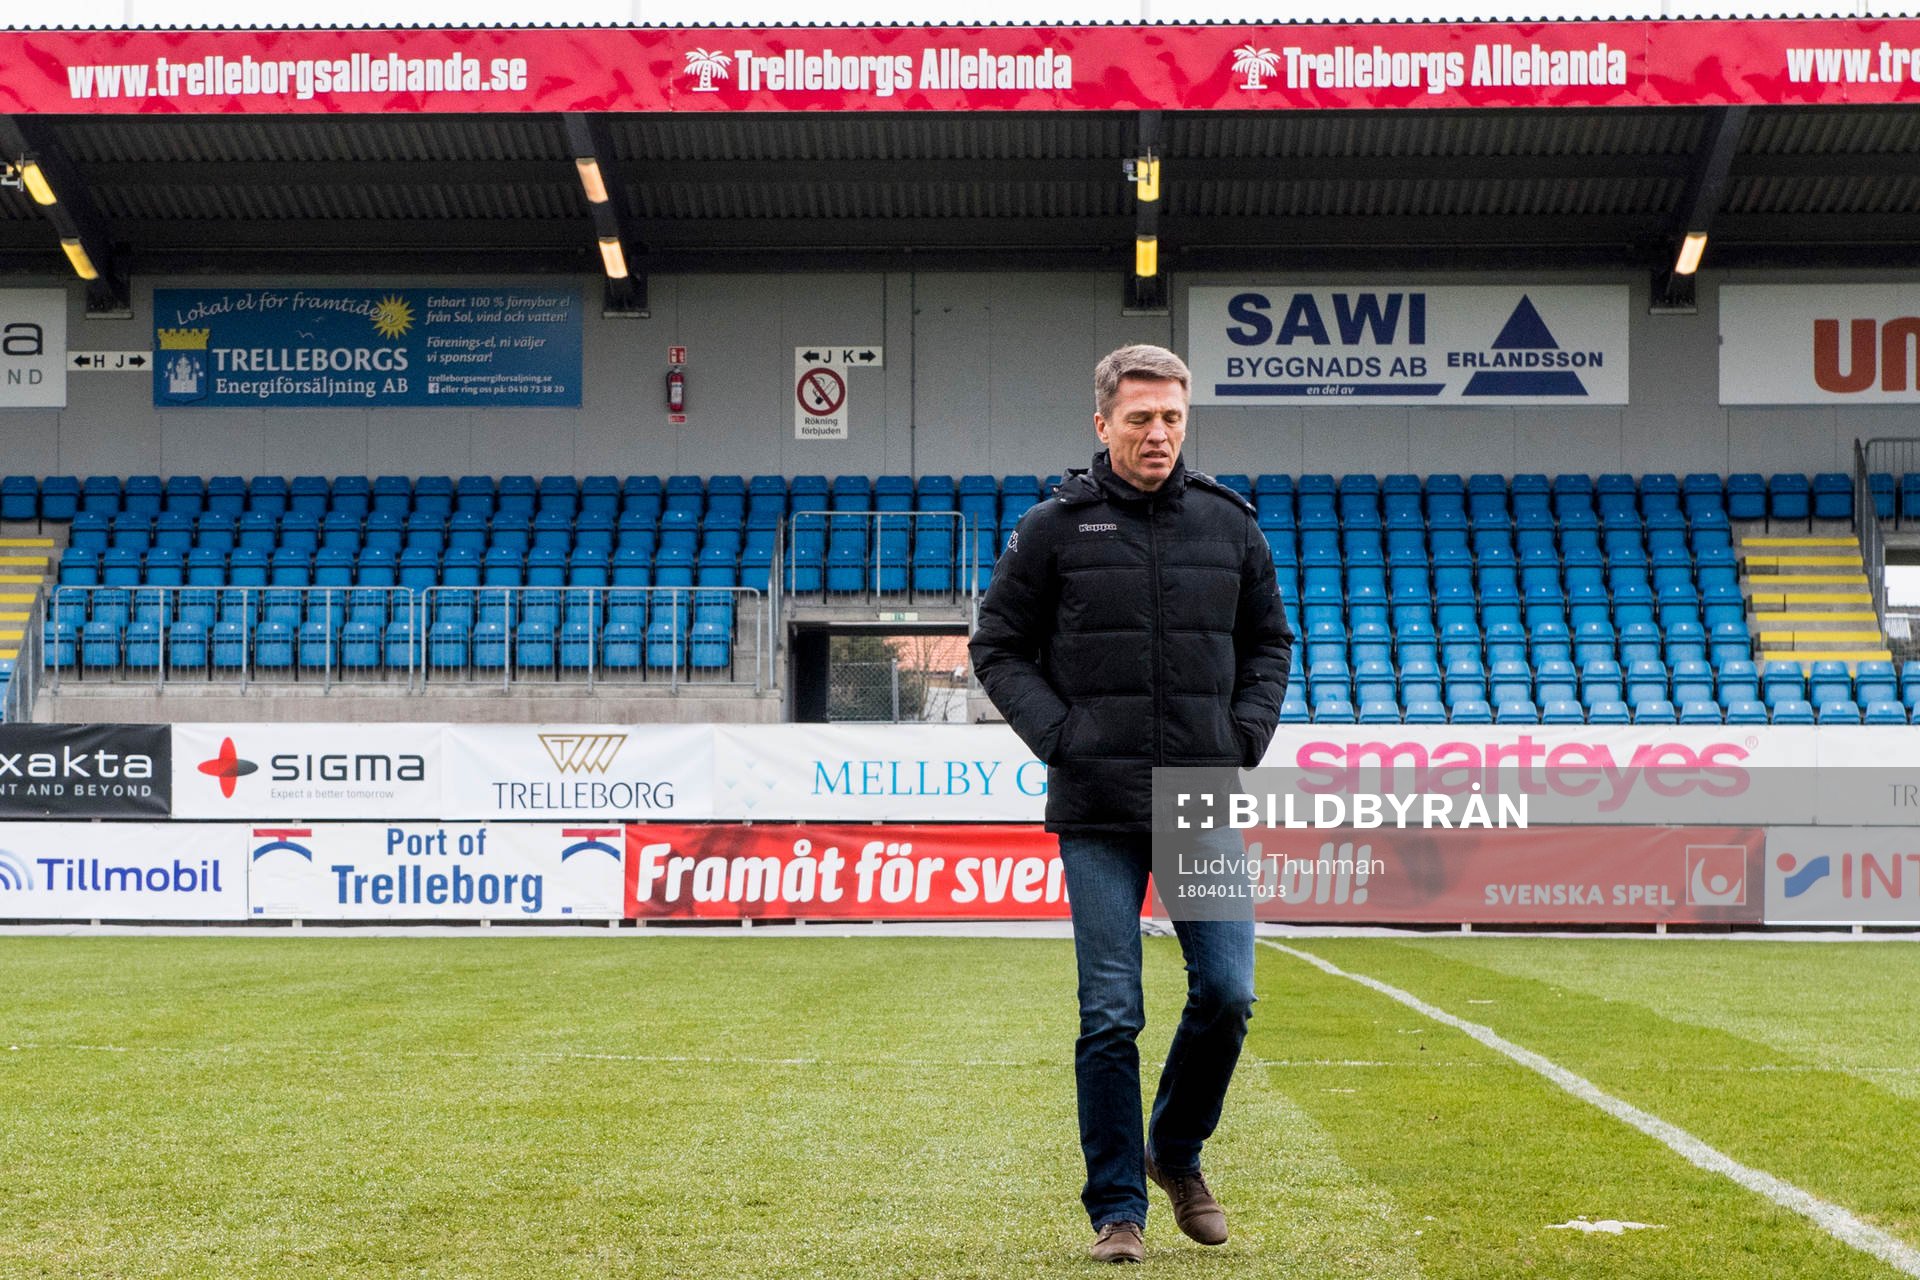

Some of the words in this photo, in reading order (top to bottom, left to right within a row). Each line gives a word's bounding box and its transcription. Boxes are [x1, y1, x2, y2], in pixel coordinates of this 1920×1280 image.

[67, 52, 528, 100] www.trelleborgsallehanda.se
[734, 48, 912, 97] Trelleborgs
[919, 47, 1073, 91] Allehanda
[1283, 45, 1464, 94] Trelleborgs
[1471, 43, 1627, 87] Allehanda
[176, 297, 233, 326] Lokal
[236, 293, 257, 311] el
[259, 292, 289, 313] för
[292, 291, 397, 324] framtiden
[426, 296, 466, 308] Enbart
[471, 296, 490, 308] 100
[505, 295, 557, 311] förnybar
[560, 296, 571, 307] el
[425, 311, 451, 326] från
[454, 311, 474, 324] Sol,
[477, 311, 501, 323] vind
[504, 311, 525, 323] och
[528, 311, 568, 323] vatten!
[1225, 293, 1426, 346] SAWI
[2, 322, 44, 356] a
[500, 336, 512, 348] ni
[514, 335, 547, 351] väljer
[93, 354, 106, 368] H
[115, 354, 125, 368] J
[212, 348, 409, 372] TRELLEBORGS
[426, 352, 437, 363] vi
[439, 351, 494, 366] sponsrar!
[823, 350, 832, 363] J
[843, 350, 855, 363] K
[1226, 356, 1382, 378] BYGGNADS
[1389, 357, 1427, 377] AB
[1447, 352, 1603, 368] ERLANDSSON
[215, 376, 377, 398] Energiförsäljning
[382, 378, 409, 393] AB
[441, 385, 459, 393] eller
[461, 385, 479, 395] ring
[1306, 385, 1319, 395] en
[1322, 384, 1339, 395] del
[1341, 386, 1355, 395] av
[801, 427, 841, 437] förbjuden
[804, 417, 838, 428] Rökning
[1079, 523, 1118, 532] Kappa
[0, 745, 152, 779] xakta
[811, 760, 1002, 796] MELLBY
[1016, 760, 1048, 797] G
[1295, 735, 1751, 812] smarteyes
[27, 783, 64, 796] AND
[74, 784, 152, 797] BEYOND
[271, 789, 304, 799] Expect
[315, 789, 344, 799] better
[346, 789, 395, 799] tomorrow
[491, 781, 675, 810] TRELLEBORG
[1889, 784, 1920, 807] TR
[387, 827, 447, 856] Port
[458, 827, 487, 856] of
[36, 858, 222, 892] Tillmobil
[636, 838, 845, 902] Framåt
[855, 841, 945, 903] för
[331, 864, 543, 913] Trelleborg
[1484, 884, 1605, 906] SVENSKA
[1612, 884, 1676, 906] SPEL
